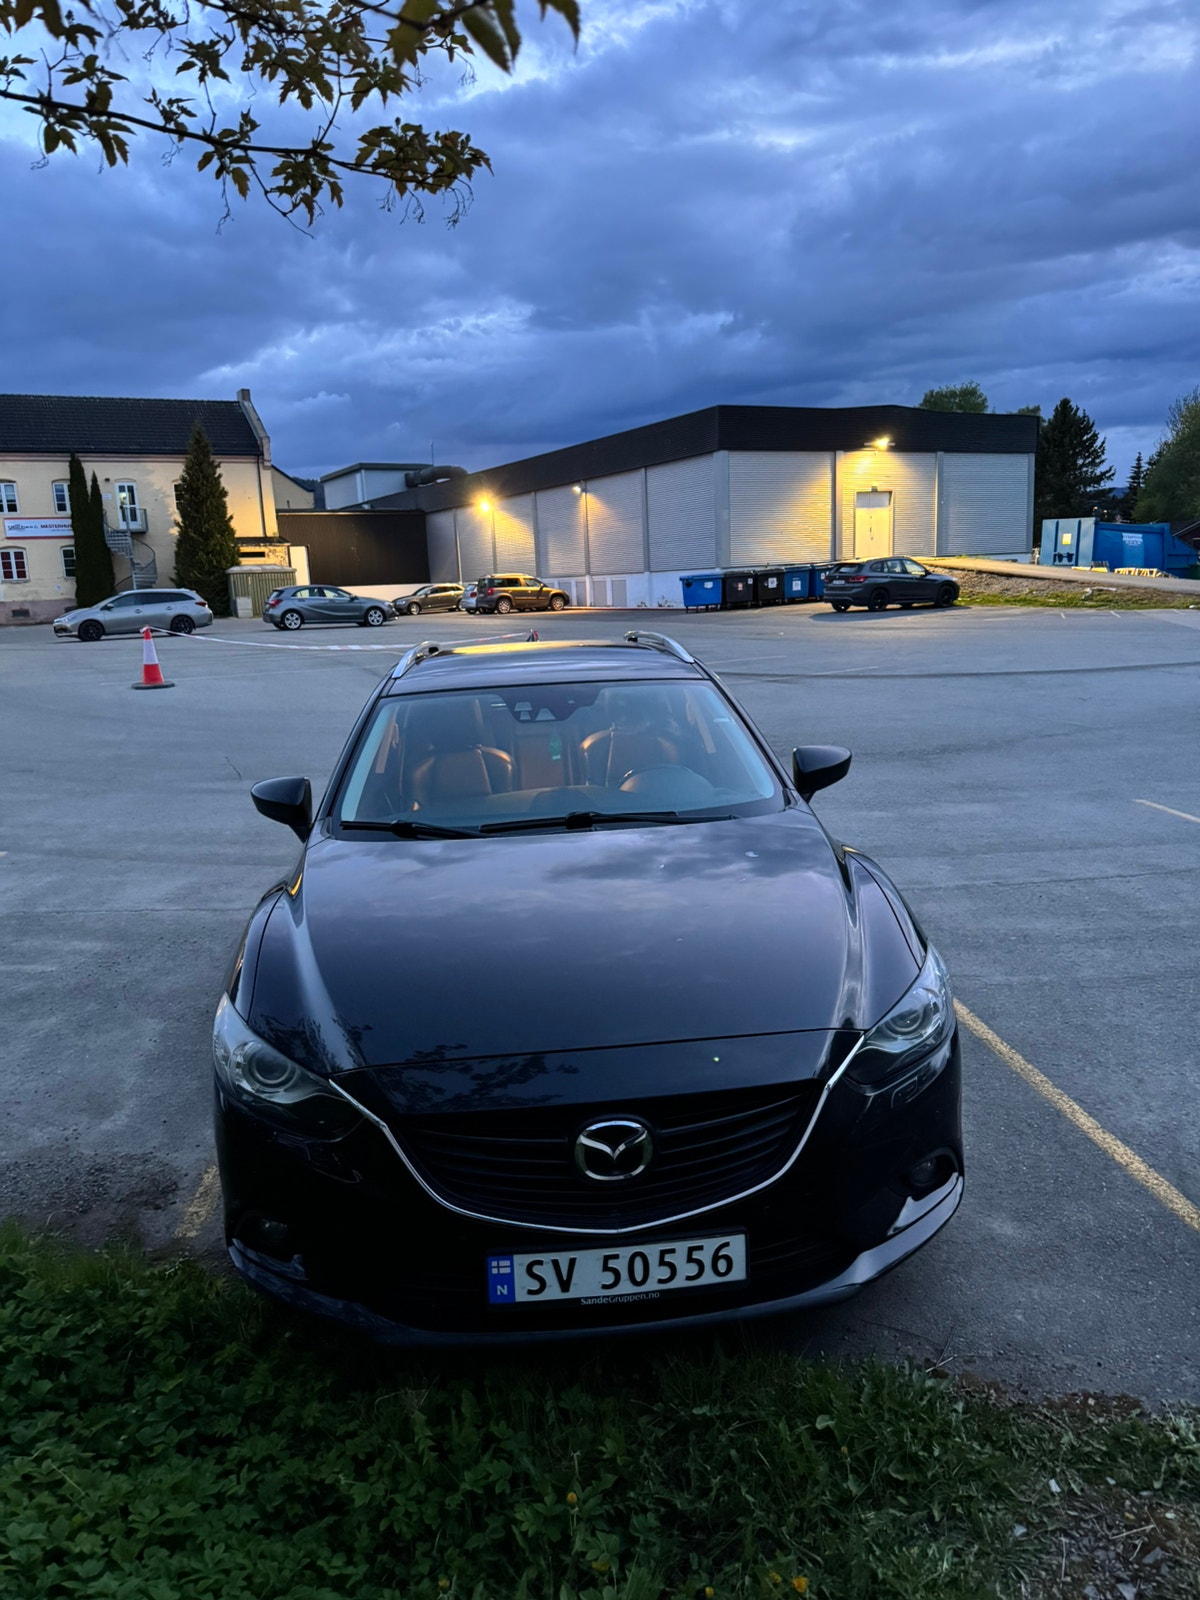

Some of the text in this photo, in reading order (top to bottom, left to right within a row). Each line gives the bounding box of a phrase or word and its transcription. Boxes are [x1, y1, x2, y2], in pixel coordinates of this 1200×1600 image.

[526, 1242, 734, 1296] SV 50556
[497, 1285, 508, 1296] N
[580, 1292, 660, 1306] SandeGruppen.no
